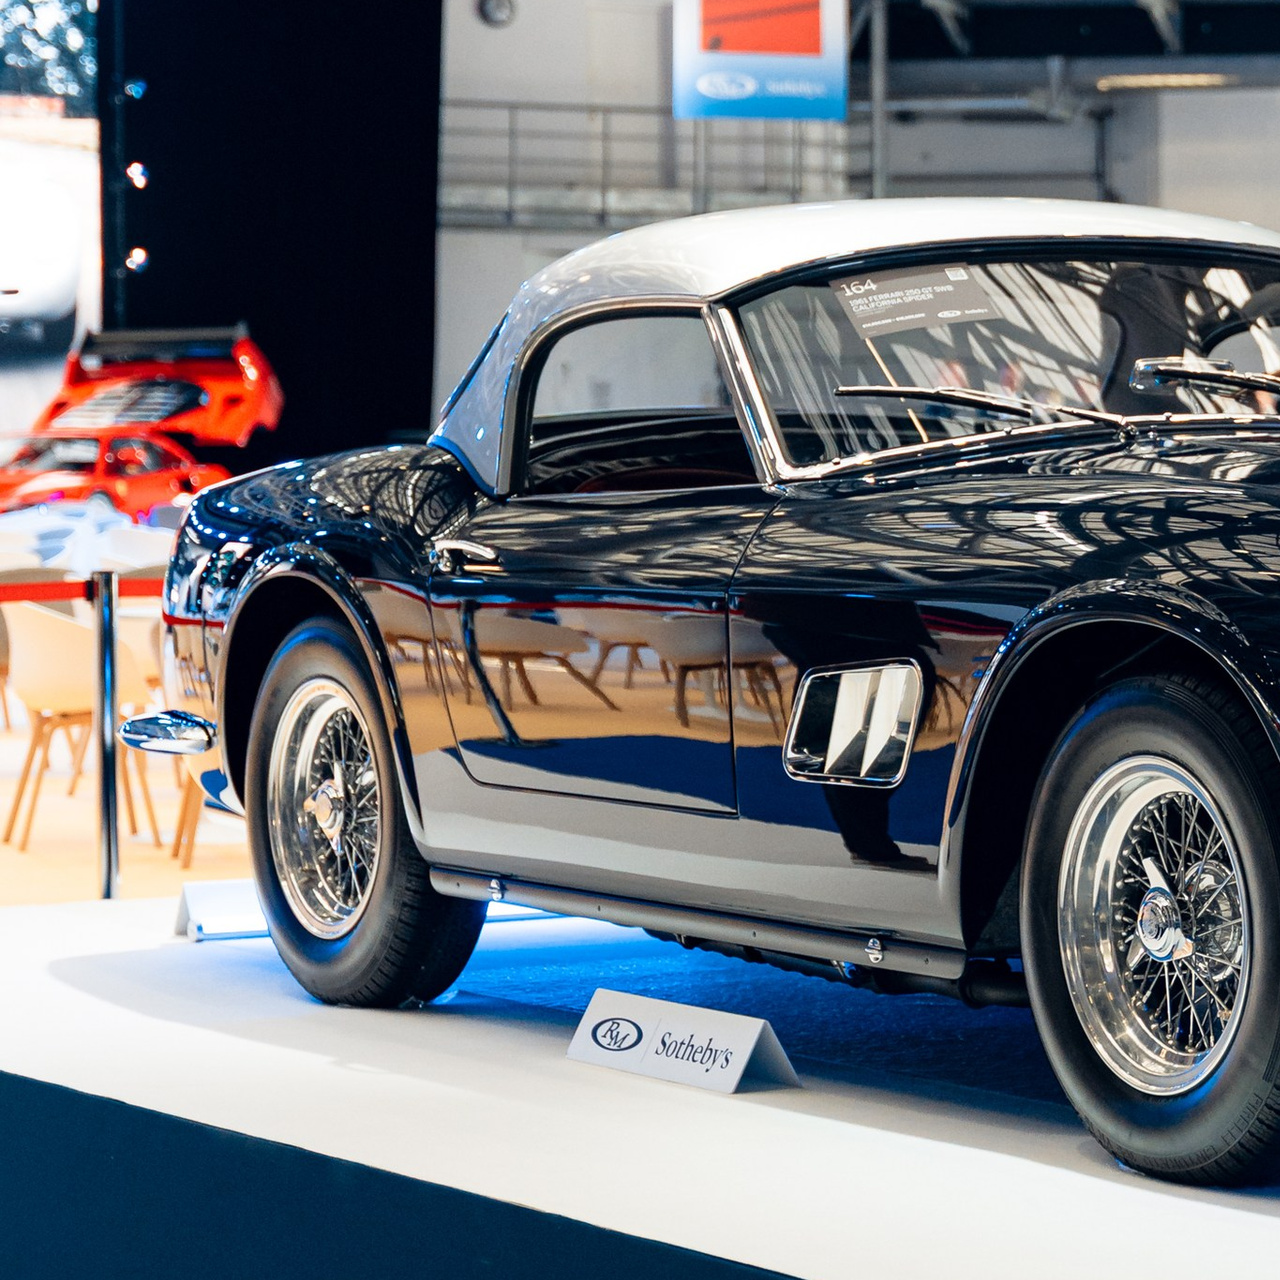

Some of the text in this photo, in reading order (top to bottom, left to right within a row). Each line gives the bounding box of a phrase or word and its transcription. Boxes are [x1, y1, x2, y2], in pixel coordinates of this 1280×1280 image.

[840, 279, 877, 296] 164
[849, 296, 869, 307] 1961
[869, 290, 903, 304] FERRARI
[905, 288, 921, 297] 250
[921, 286, 933, 294] GT
[852, 298, 902, 312] CALIFORNIA
[903, 293, 934, 304] SPIDER
[655, 1031, 733, 1072] Sotheby's
[1221, 1092, 1263, 1148] PIRELLI
